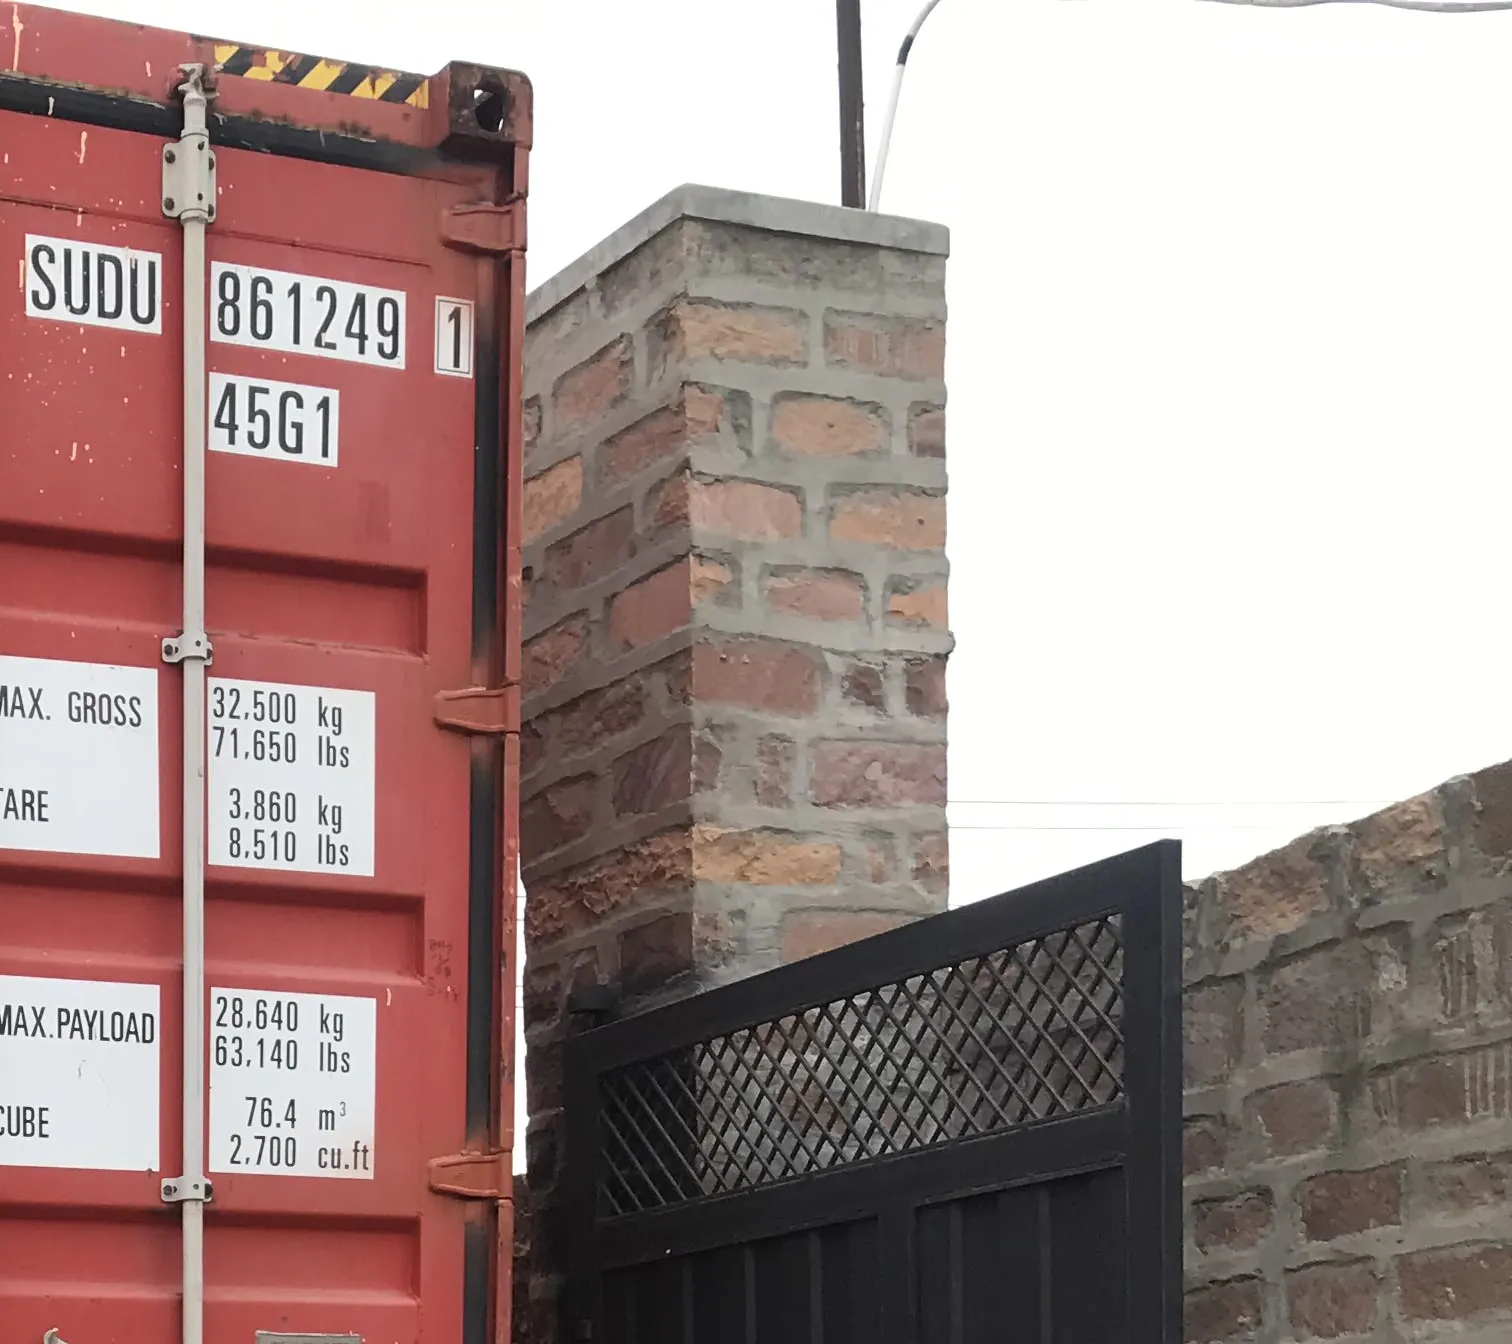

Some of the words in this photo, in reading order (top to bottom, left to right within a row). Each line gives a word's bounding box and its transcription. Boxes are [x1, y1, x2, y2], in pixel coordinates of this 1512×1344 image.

[30, 244, 157, 325] SUDU
[217, 270, 401, 361] 861249
[446, 305, 462, 370] 1
[214, 382, 331, 459] 45G1
[67, 691, 142, 728] GROSS
[212, 686, 297, 725] 32,500
[317, 697, 343, 736] kg
[212, 726, 297, 764] 71,650
[317, 735, 350, 769] lbs
[228, 788, 297, 824] 3,860
[317, 795, 343, 834] kg
[228, 827, 297, 863] 8,510
[317, 834, 350, 867] lbs
[215, 996, 299, 1033] 28,640
[318, 1003, 345, 1042] kg
[214, 1035, 299, 1071] 63,140
[318, 1041, 351, 1074] lbs
[245, 1096, 297, 1129] 76.4
[229, 1134, 297, 1169] 2,700
[317, 1140, 370, 1172] cu.ft
